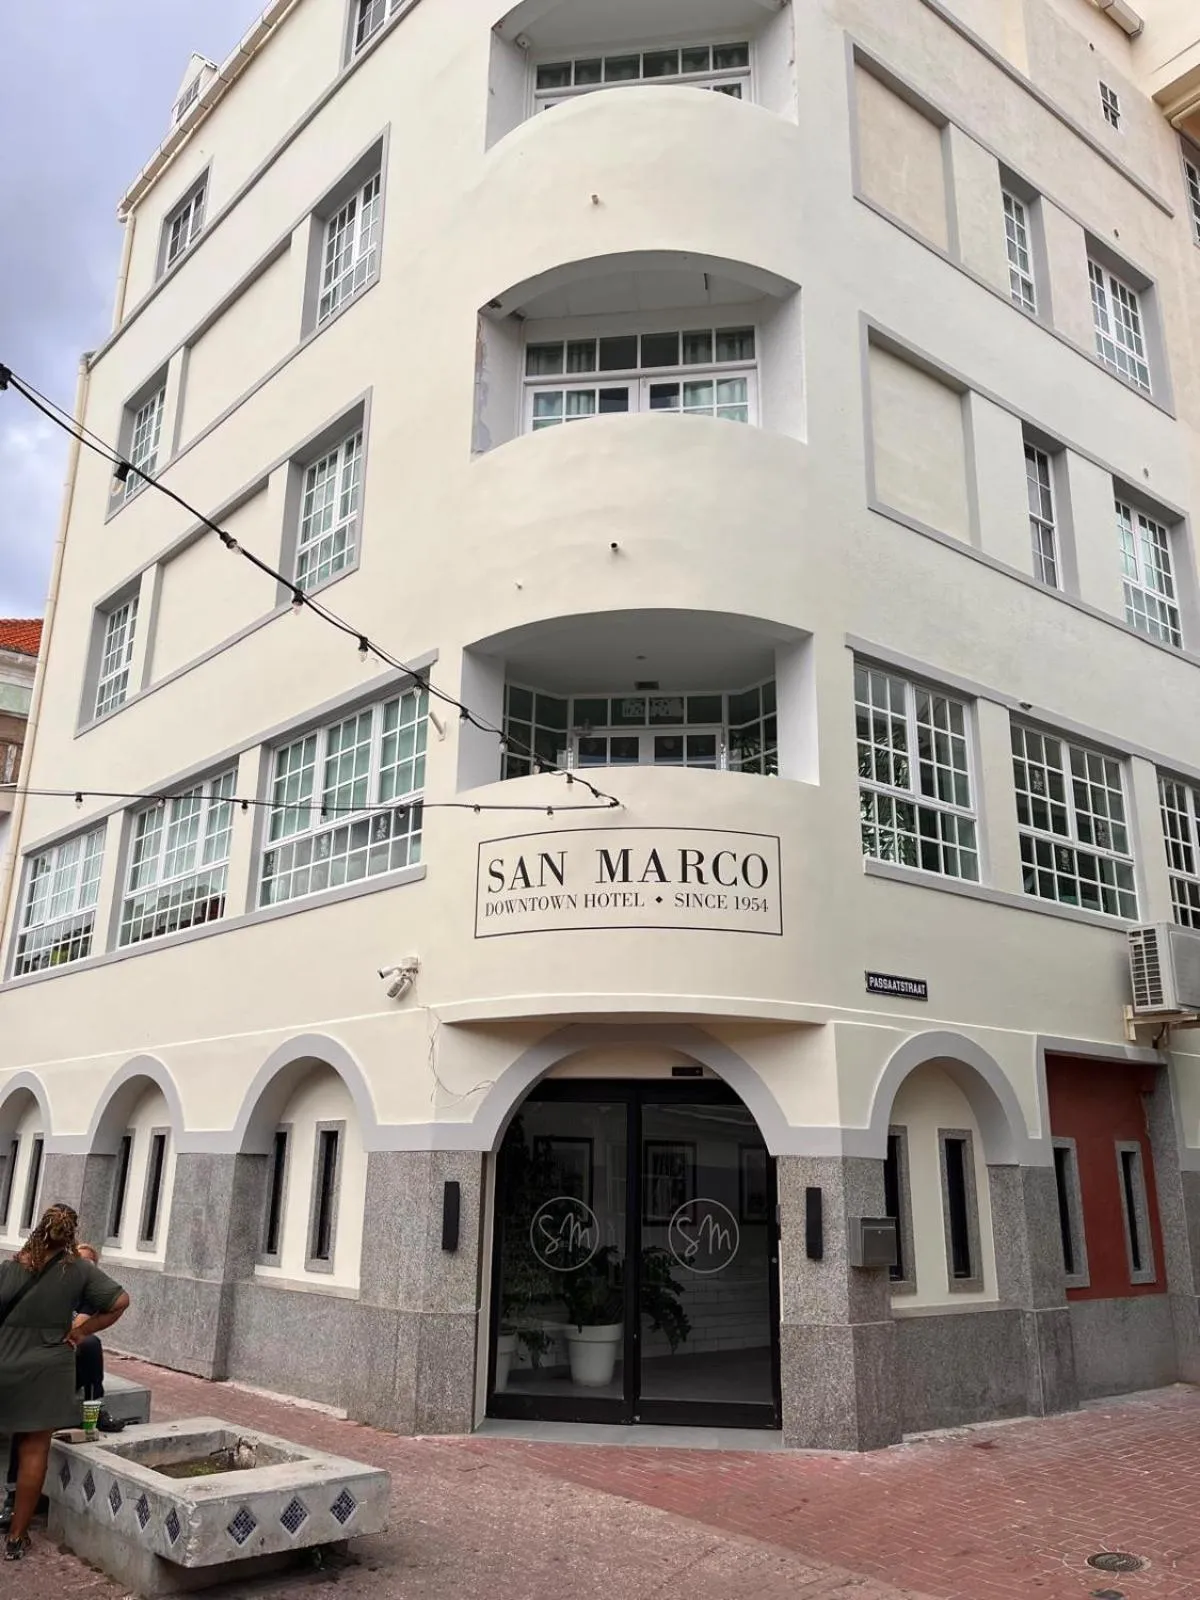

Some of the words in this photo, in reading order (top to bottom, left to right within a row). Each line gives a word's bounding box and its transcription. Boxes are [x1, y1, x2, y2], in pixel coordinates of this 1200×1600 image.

[487, 850, 568, 893] SAN
[595, 847, 769, 889] MARCO
[484, 894, 578, 917] DOWNTOWN
[584, 892, 645, 909] HOTEL
[674, 892, 728, 910] SINCE
[735, 896, 769, 913] 1954
[869, 976, 926, 995] PASSAATSTRAAT
